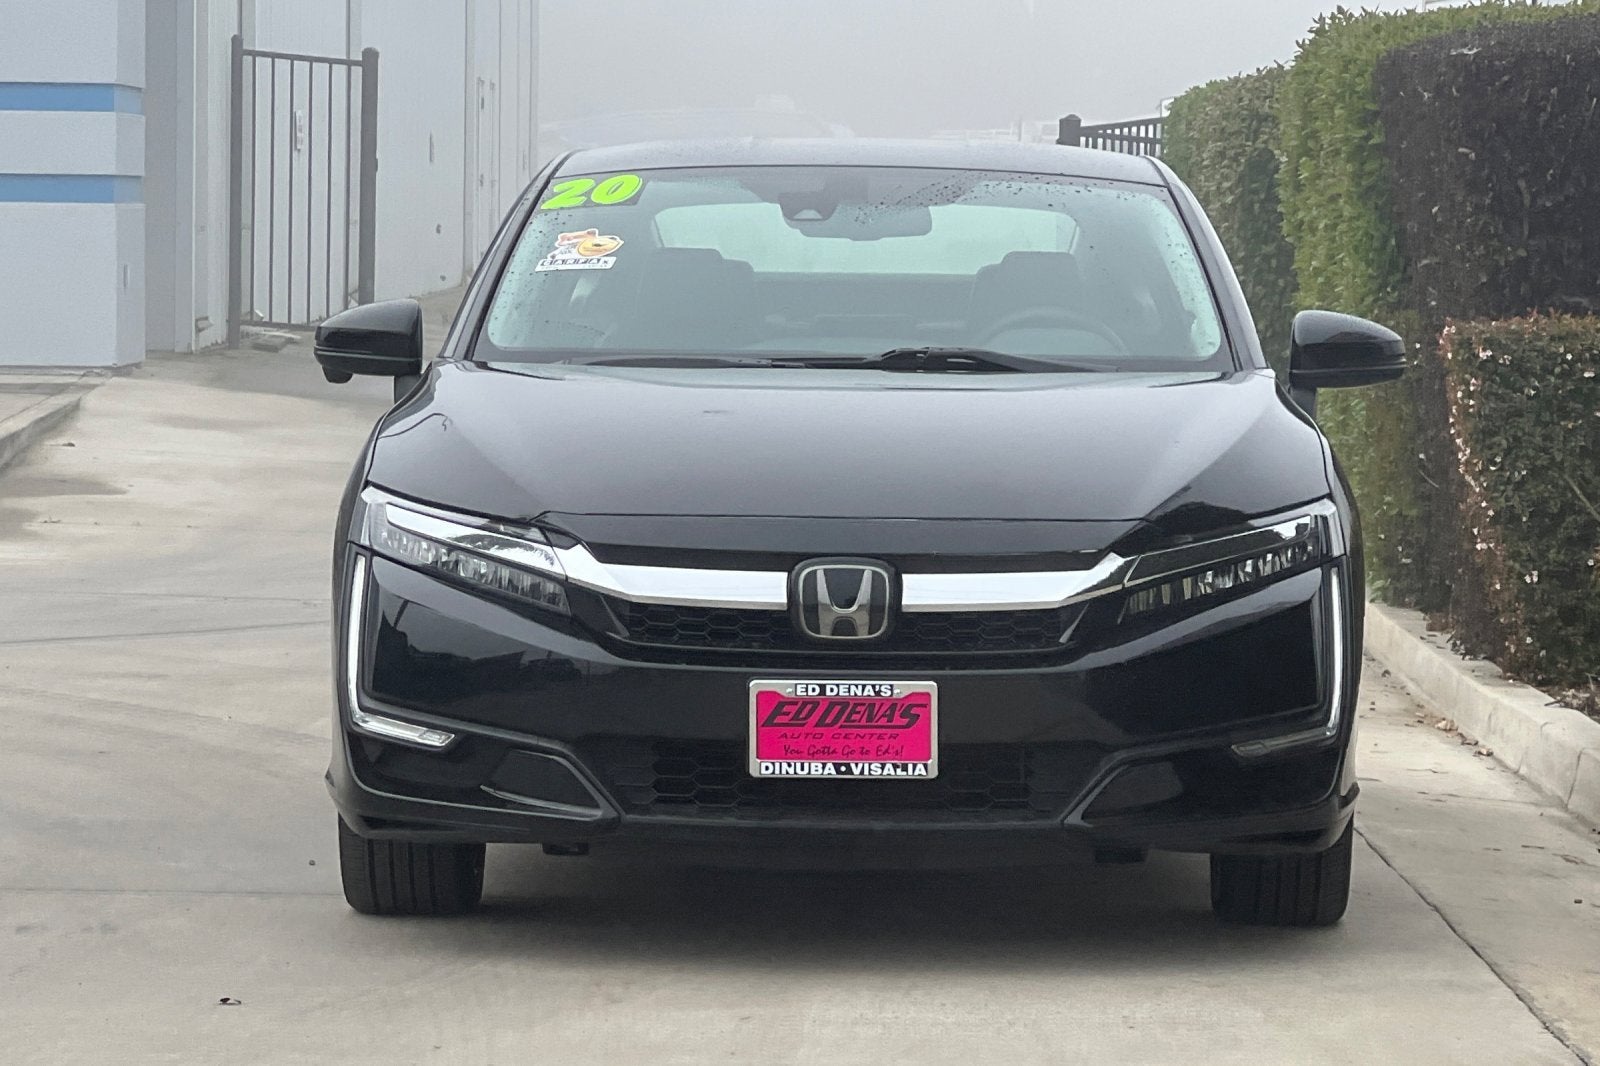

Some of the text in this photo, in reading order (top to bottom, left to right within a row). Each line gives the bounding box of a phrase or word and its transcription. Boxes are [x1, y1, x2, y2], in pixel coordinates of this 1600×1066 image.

[540, 174, 642, 209] 20
[796, 684, 892, 697] ED DENA'S
[761, 700, 929, 730] ED DENA'S
[778, 732, 900, 740] AUTO CENTER
[783, 744, 904, 758] You Gotta Go to Ed's!
[760, 762, 927, 775] DINUBA VISALIA
